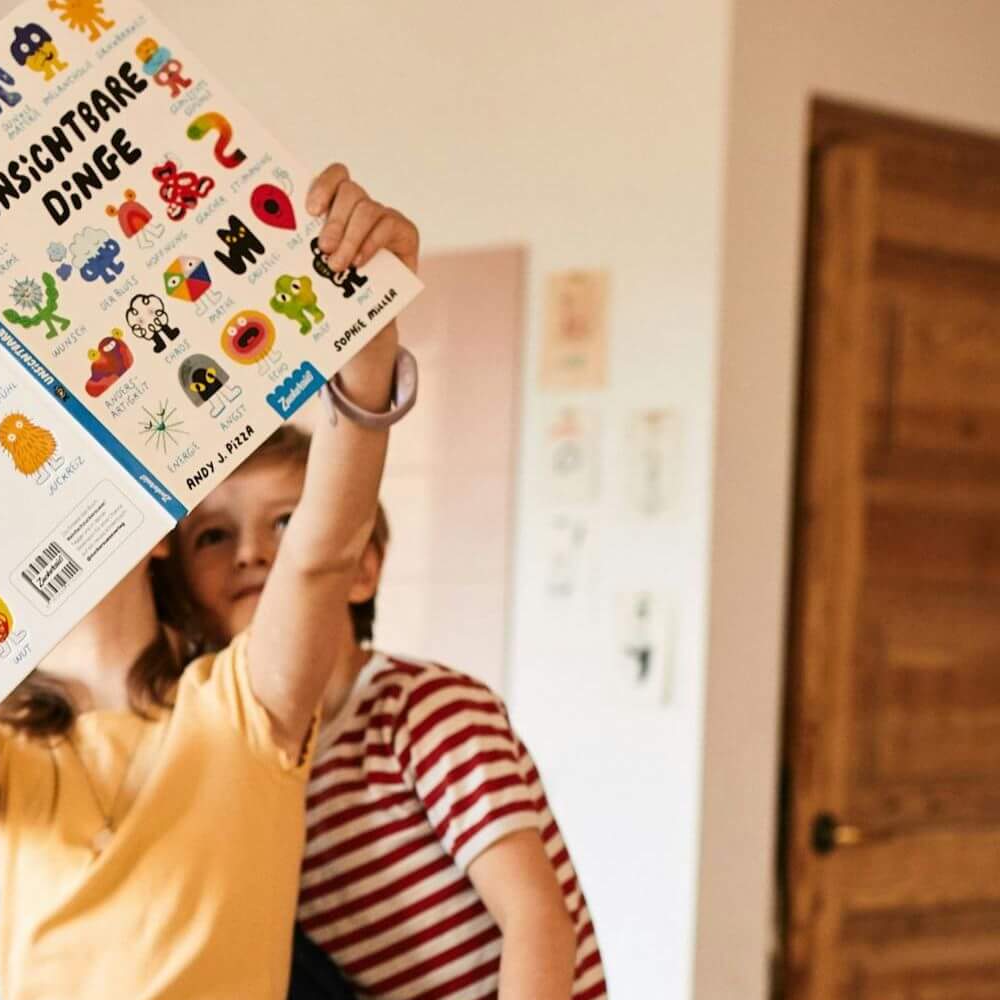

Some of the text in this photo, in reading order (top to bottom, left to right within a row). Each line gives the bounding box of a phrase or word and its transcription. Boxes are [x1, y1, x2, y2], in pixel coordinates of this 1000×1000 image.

[50, 323, 88, 358] WUNSCH
[162, 338, 192, 365] CHAOS
[217, 402, 249, 431] ANGST
[183, 458, 218, 491] ANDY
[213, 449, 228, 464] J.
[10, 642, 33, 665] WUT
